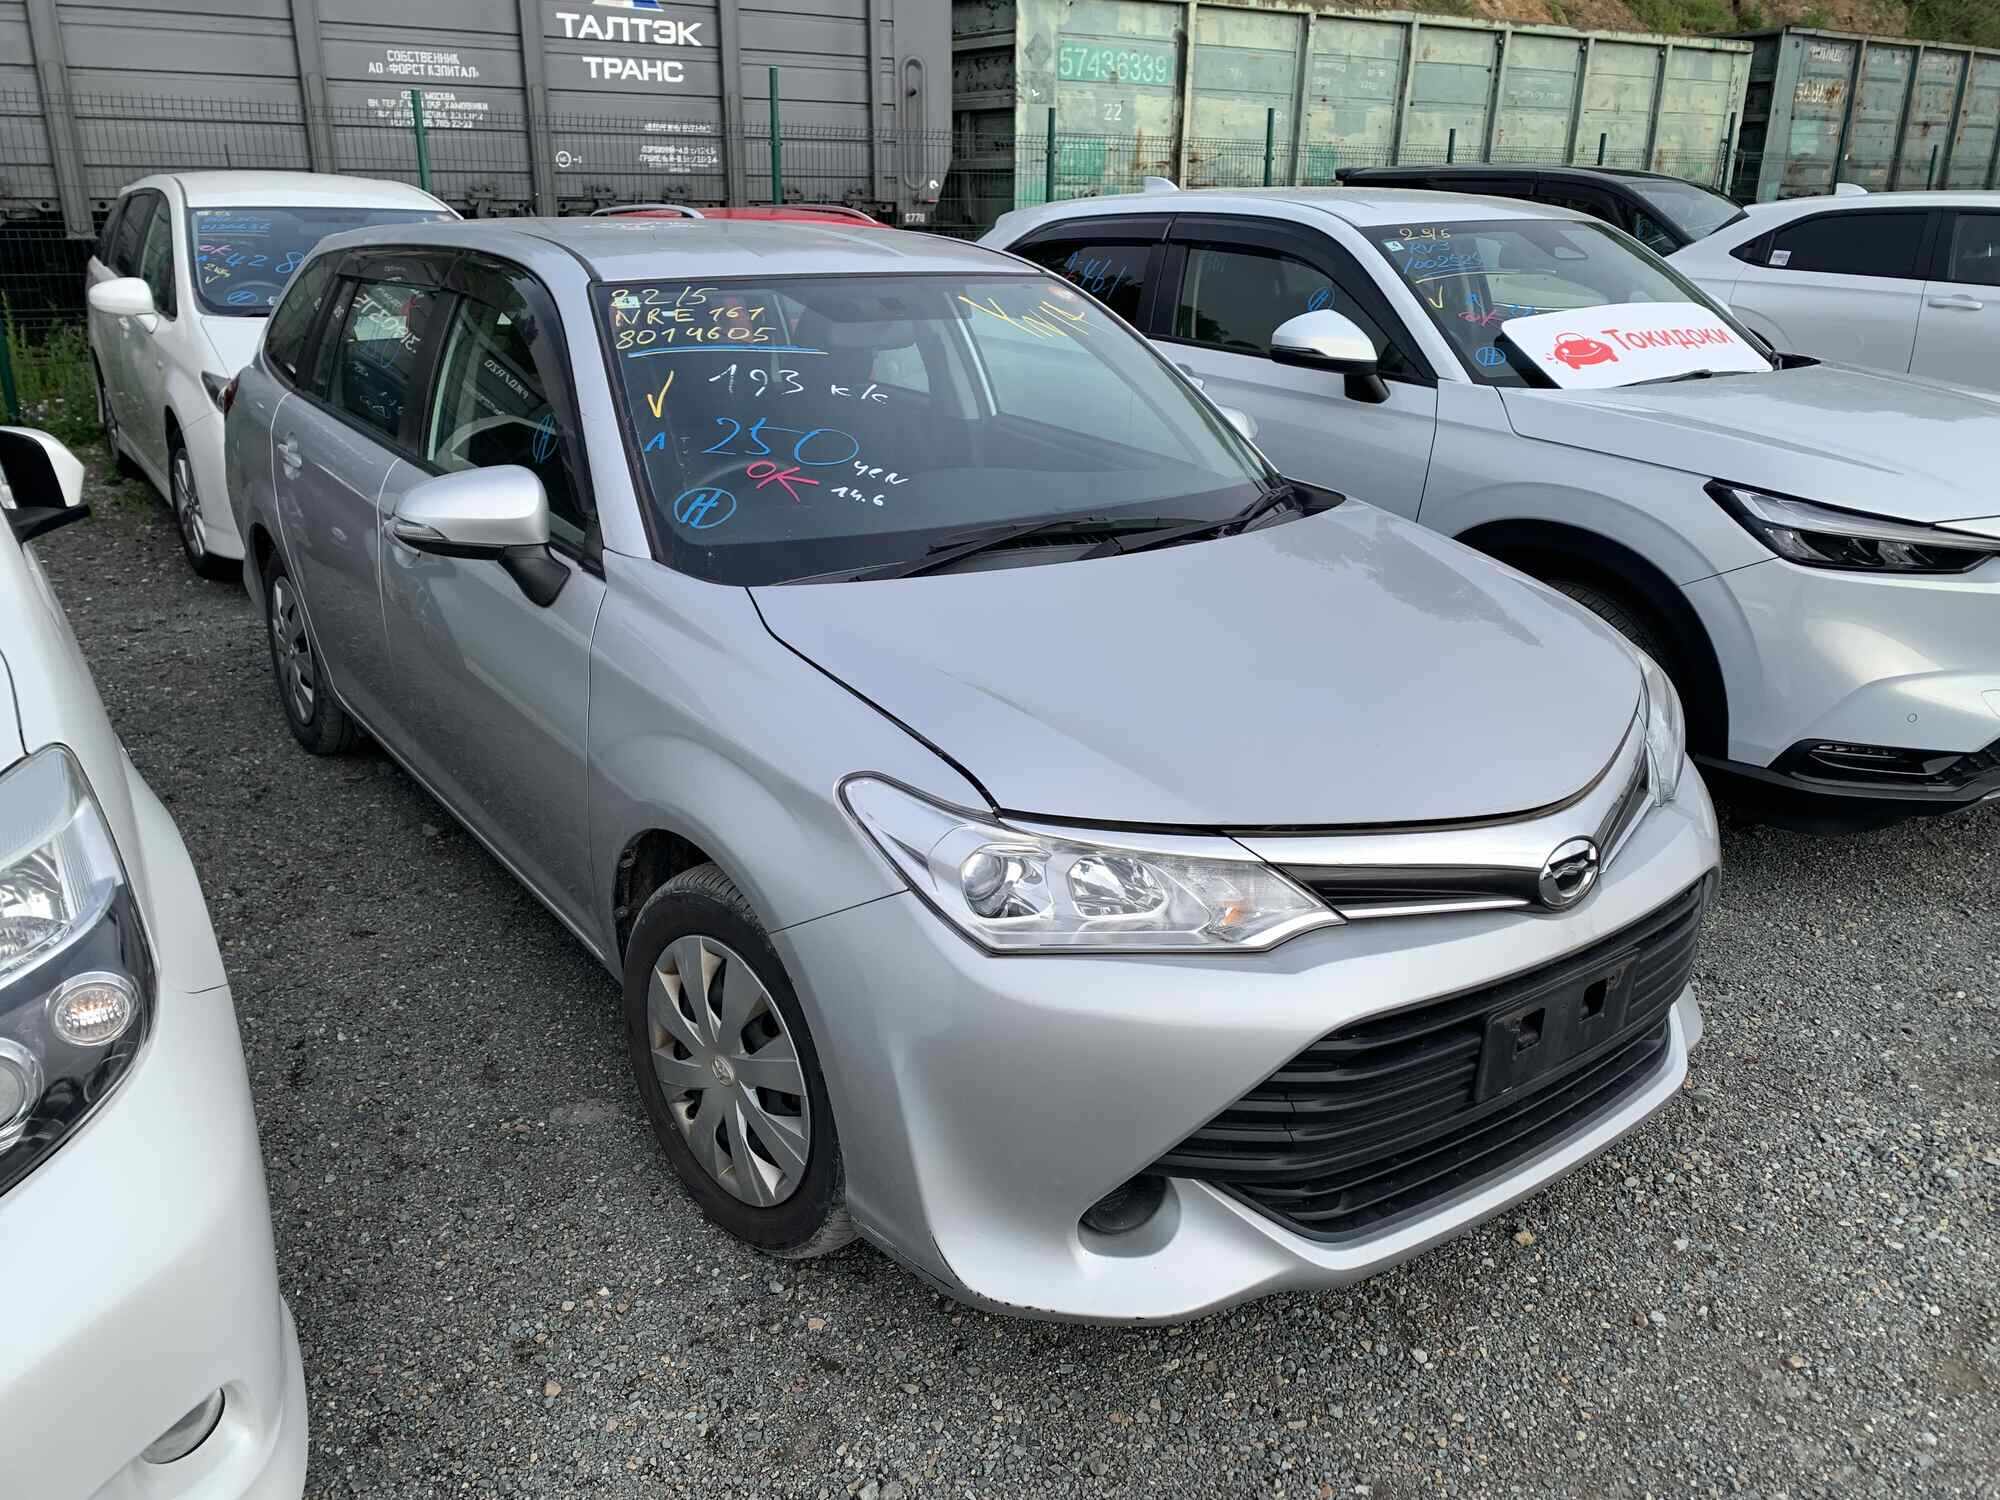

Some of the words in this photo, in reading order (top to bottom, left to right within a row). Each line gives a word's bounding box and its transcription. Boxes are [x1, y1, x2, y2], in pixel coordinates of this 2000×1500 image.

[556, 12, 703, 47] ТАЛТЭК
[582, 56, 685, 83] ТРАНС
[1058, 46, 1169, 84] 57436339
[1103, 103, 1122, 121] 22
[701, 417, 860, 466] 250
[746, 460, 820, 503] OK
